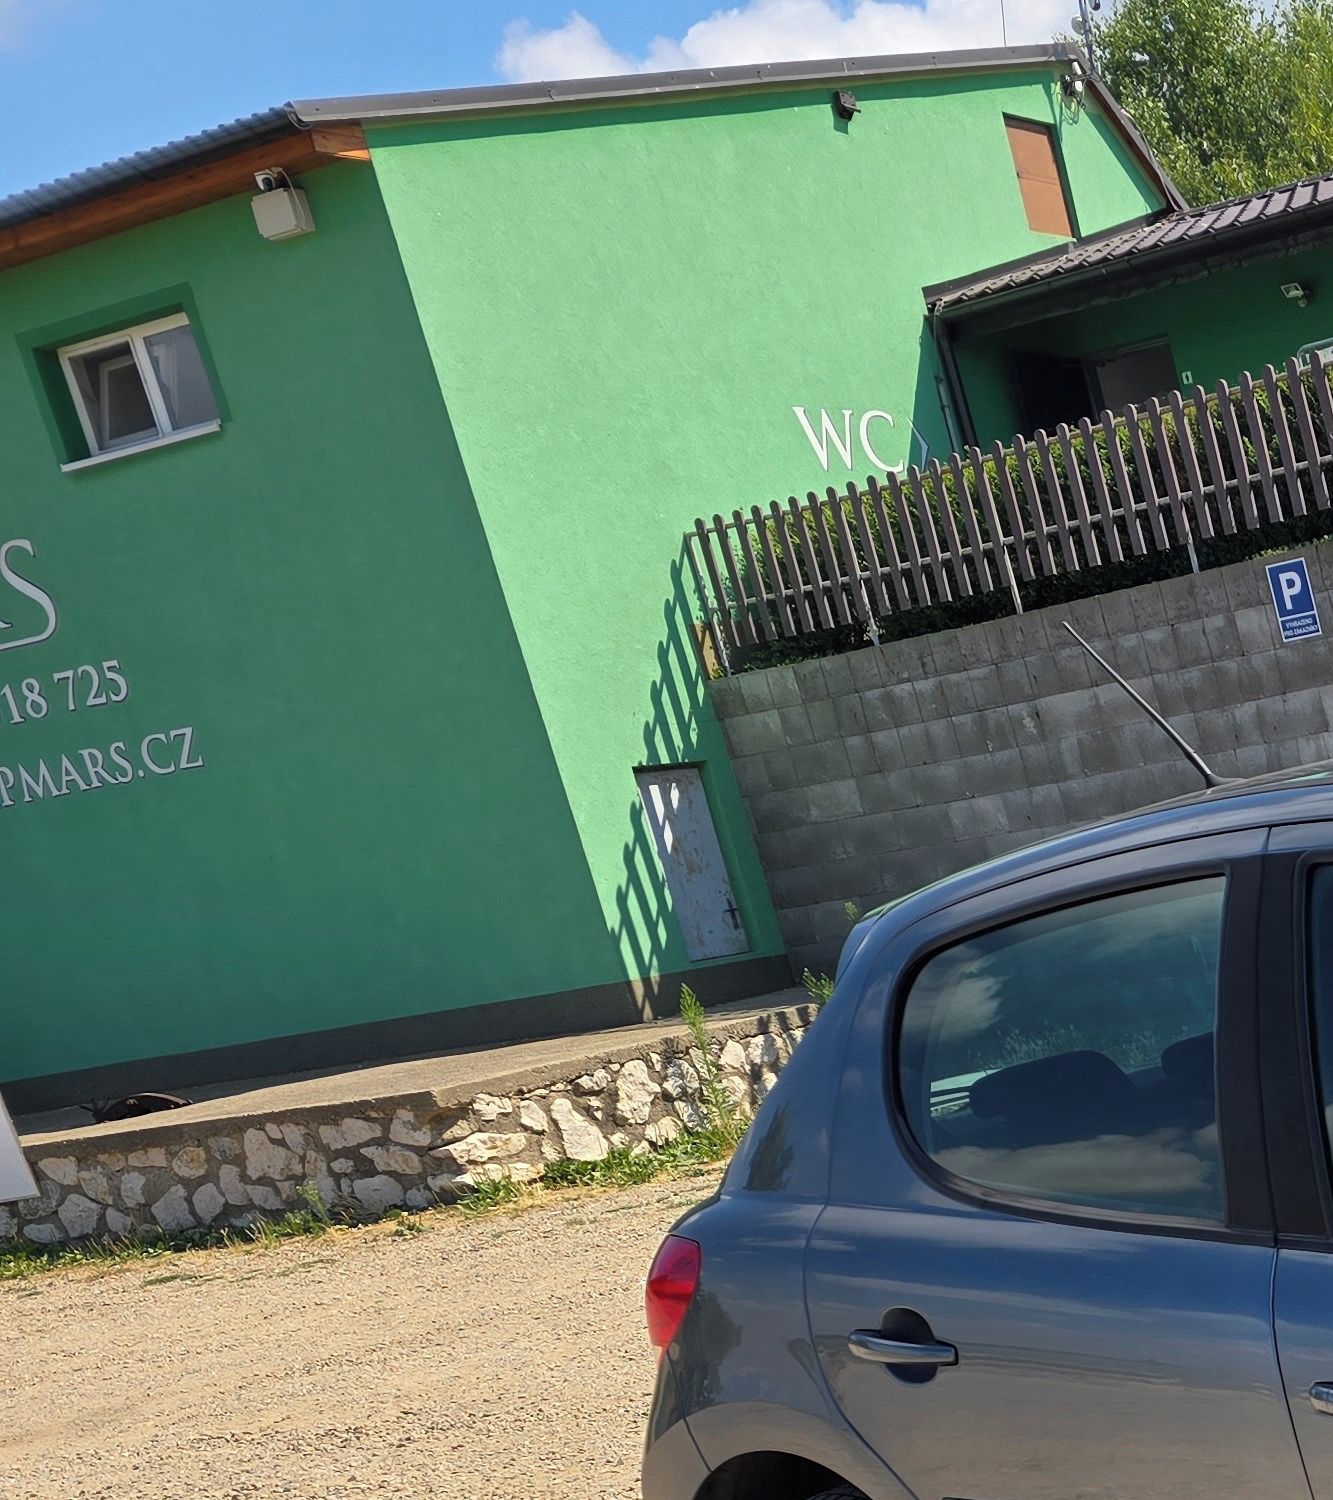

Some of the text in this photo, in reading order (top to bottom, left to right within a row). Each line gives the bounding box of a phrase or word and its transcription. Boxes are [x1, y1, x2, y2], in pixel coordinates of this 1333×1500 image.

[792, 406, 904, 474] WC
[0, 538, 57, 650] S
[1279, 571, 1301, 610] P
[53, 660, 128, 711] 725
